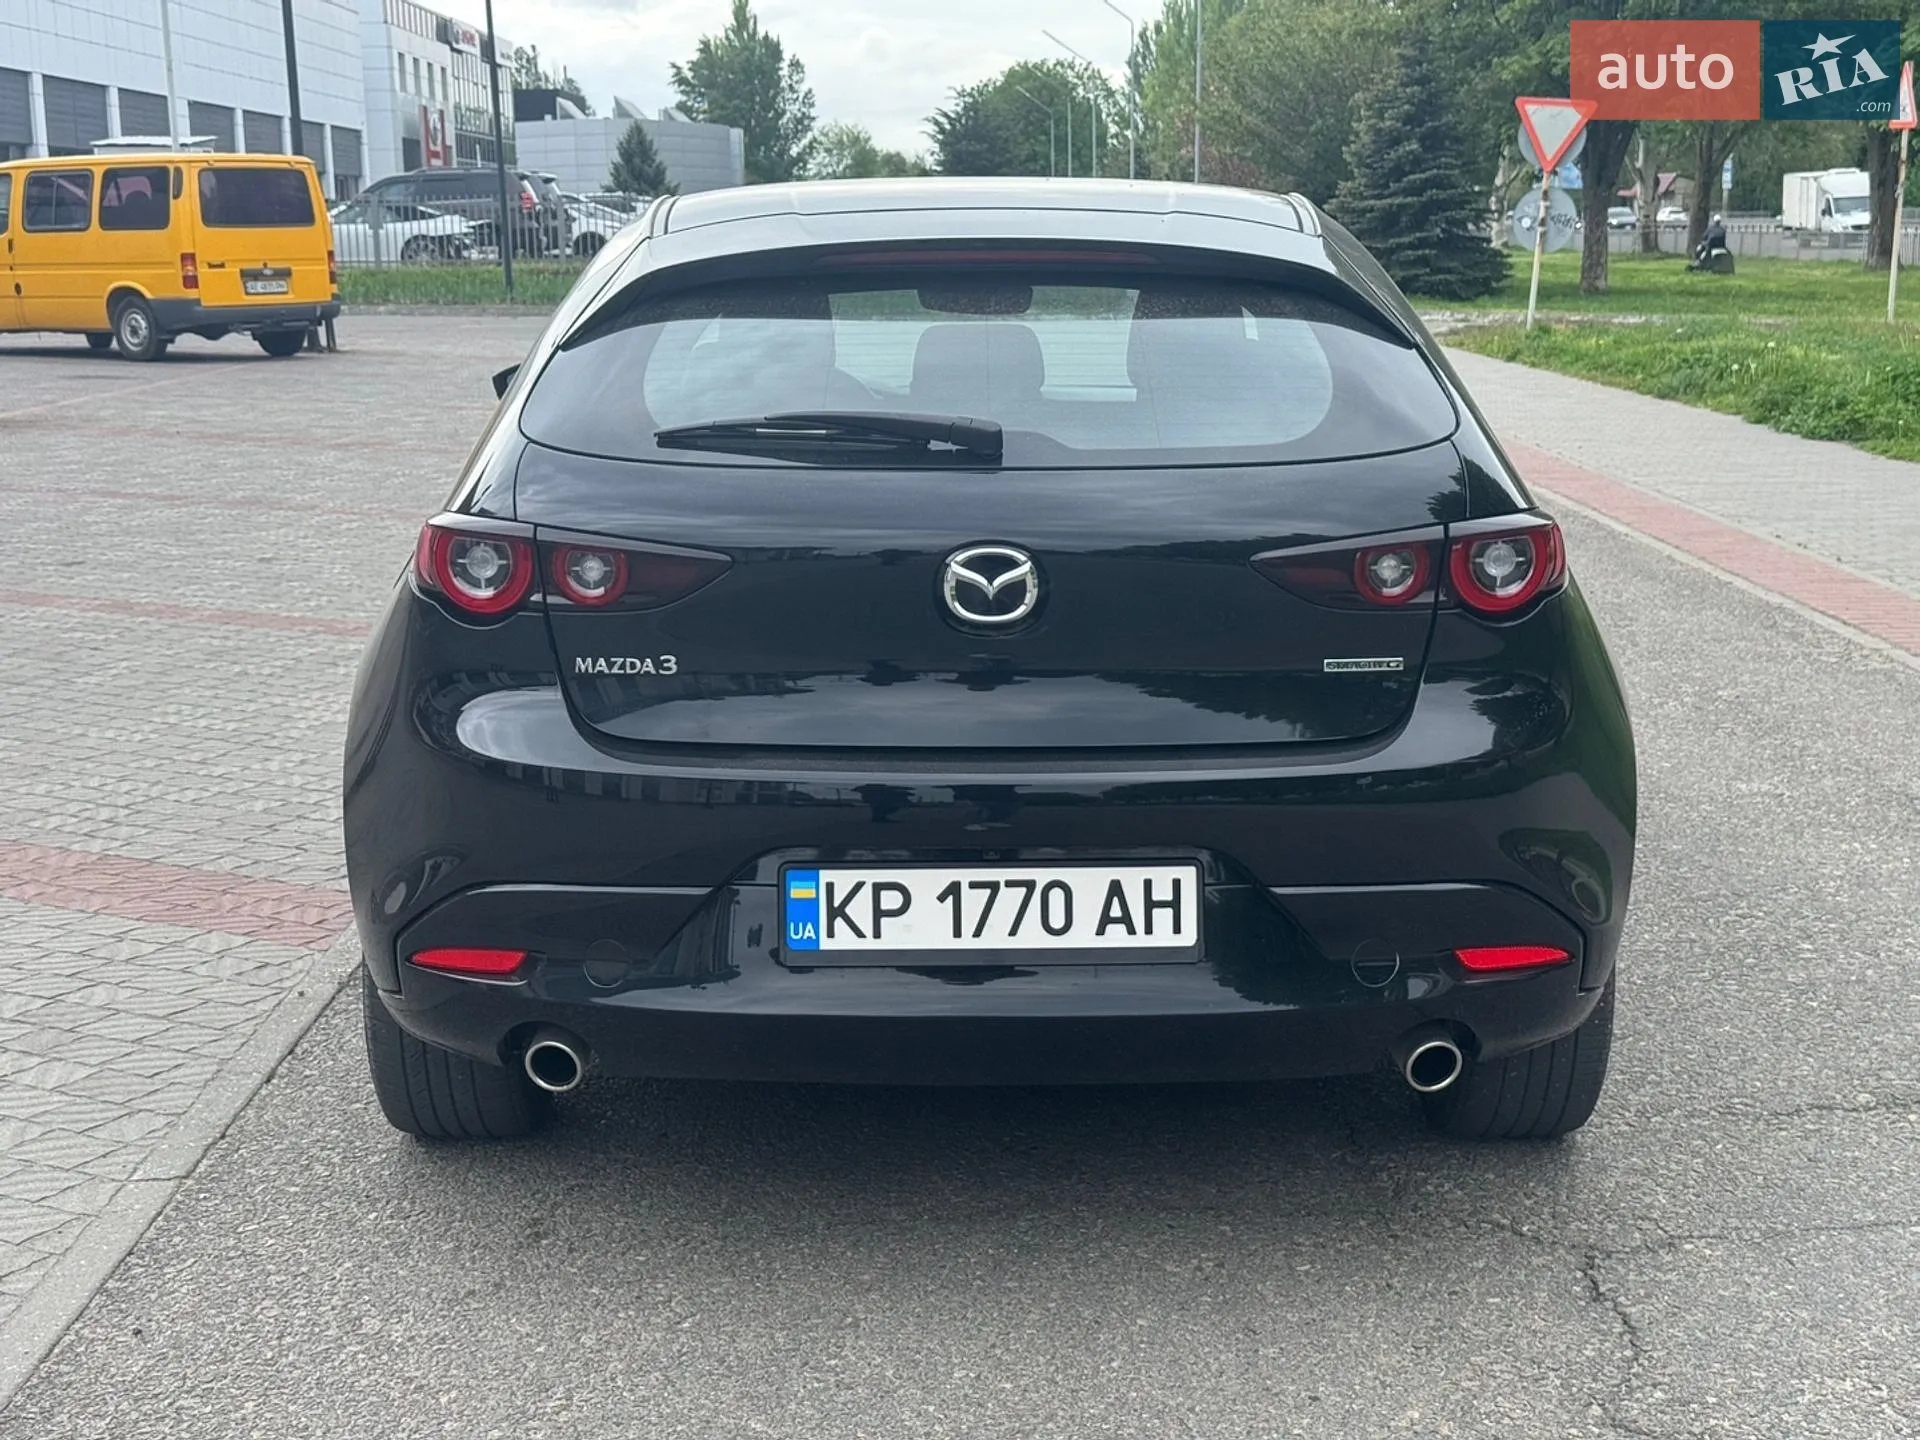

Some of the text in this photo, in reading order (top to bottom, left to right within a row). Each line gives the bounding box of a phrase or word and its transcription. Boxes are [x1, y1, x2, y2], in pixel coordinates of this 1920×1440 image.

[825, 878, 1182, 939] KP 1770 AH
[790, 922, 817, 939] UA
